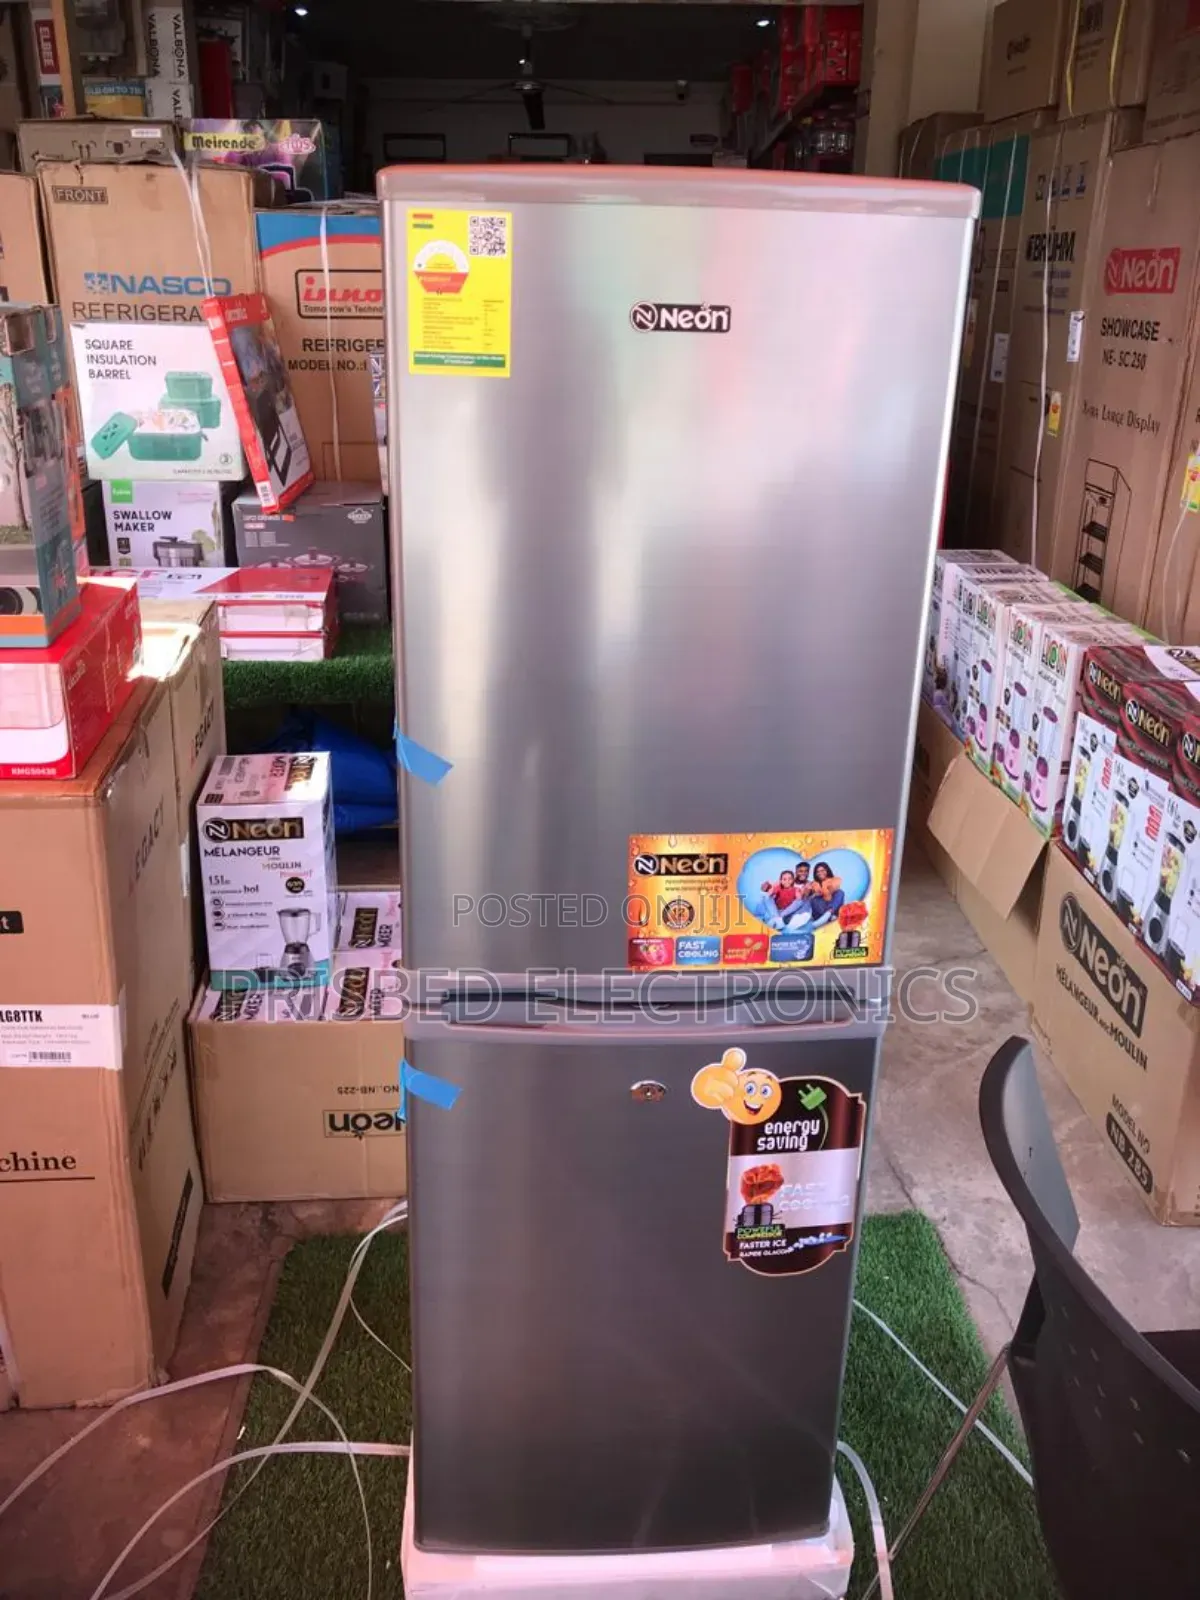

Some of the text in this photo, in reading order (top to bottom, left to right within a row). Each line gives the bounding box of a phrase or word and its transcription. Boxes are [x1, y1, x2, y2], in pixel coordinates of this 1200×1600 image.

[173, 12, 186, 83] VALBONA
[191, 134, 257, 149] Meirende
[56, 188, 103, 202] FRONT
[111, 274, 231, 296] NASCO
[304, 304, 353, 313] Tomorow's
[1100, 317, 1160, 341] SHOWCASE
[85, 339, 133, 350] SQUARE
[86, 354, 156, 366] INSULATION
[289, 360, 332, 370] MODEL
[88, 368, 131, 380] BARREL
[1126, 408, 1161, 437] Display
[113, 510, 172, 521] SWALLOW
[114, 522, 155, 532] MAKER
[678, 941, 706, 950] FAST
[677, 949, 720, 959] COOLING
[1111, 1022, 1148, 1071] MOULIN
[764, 1119, 821, 1137] energy
[757, 1132, 809, 1152] saving
[740, 1239, 787, 1250] FASTER ICE
